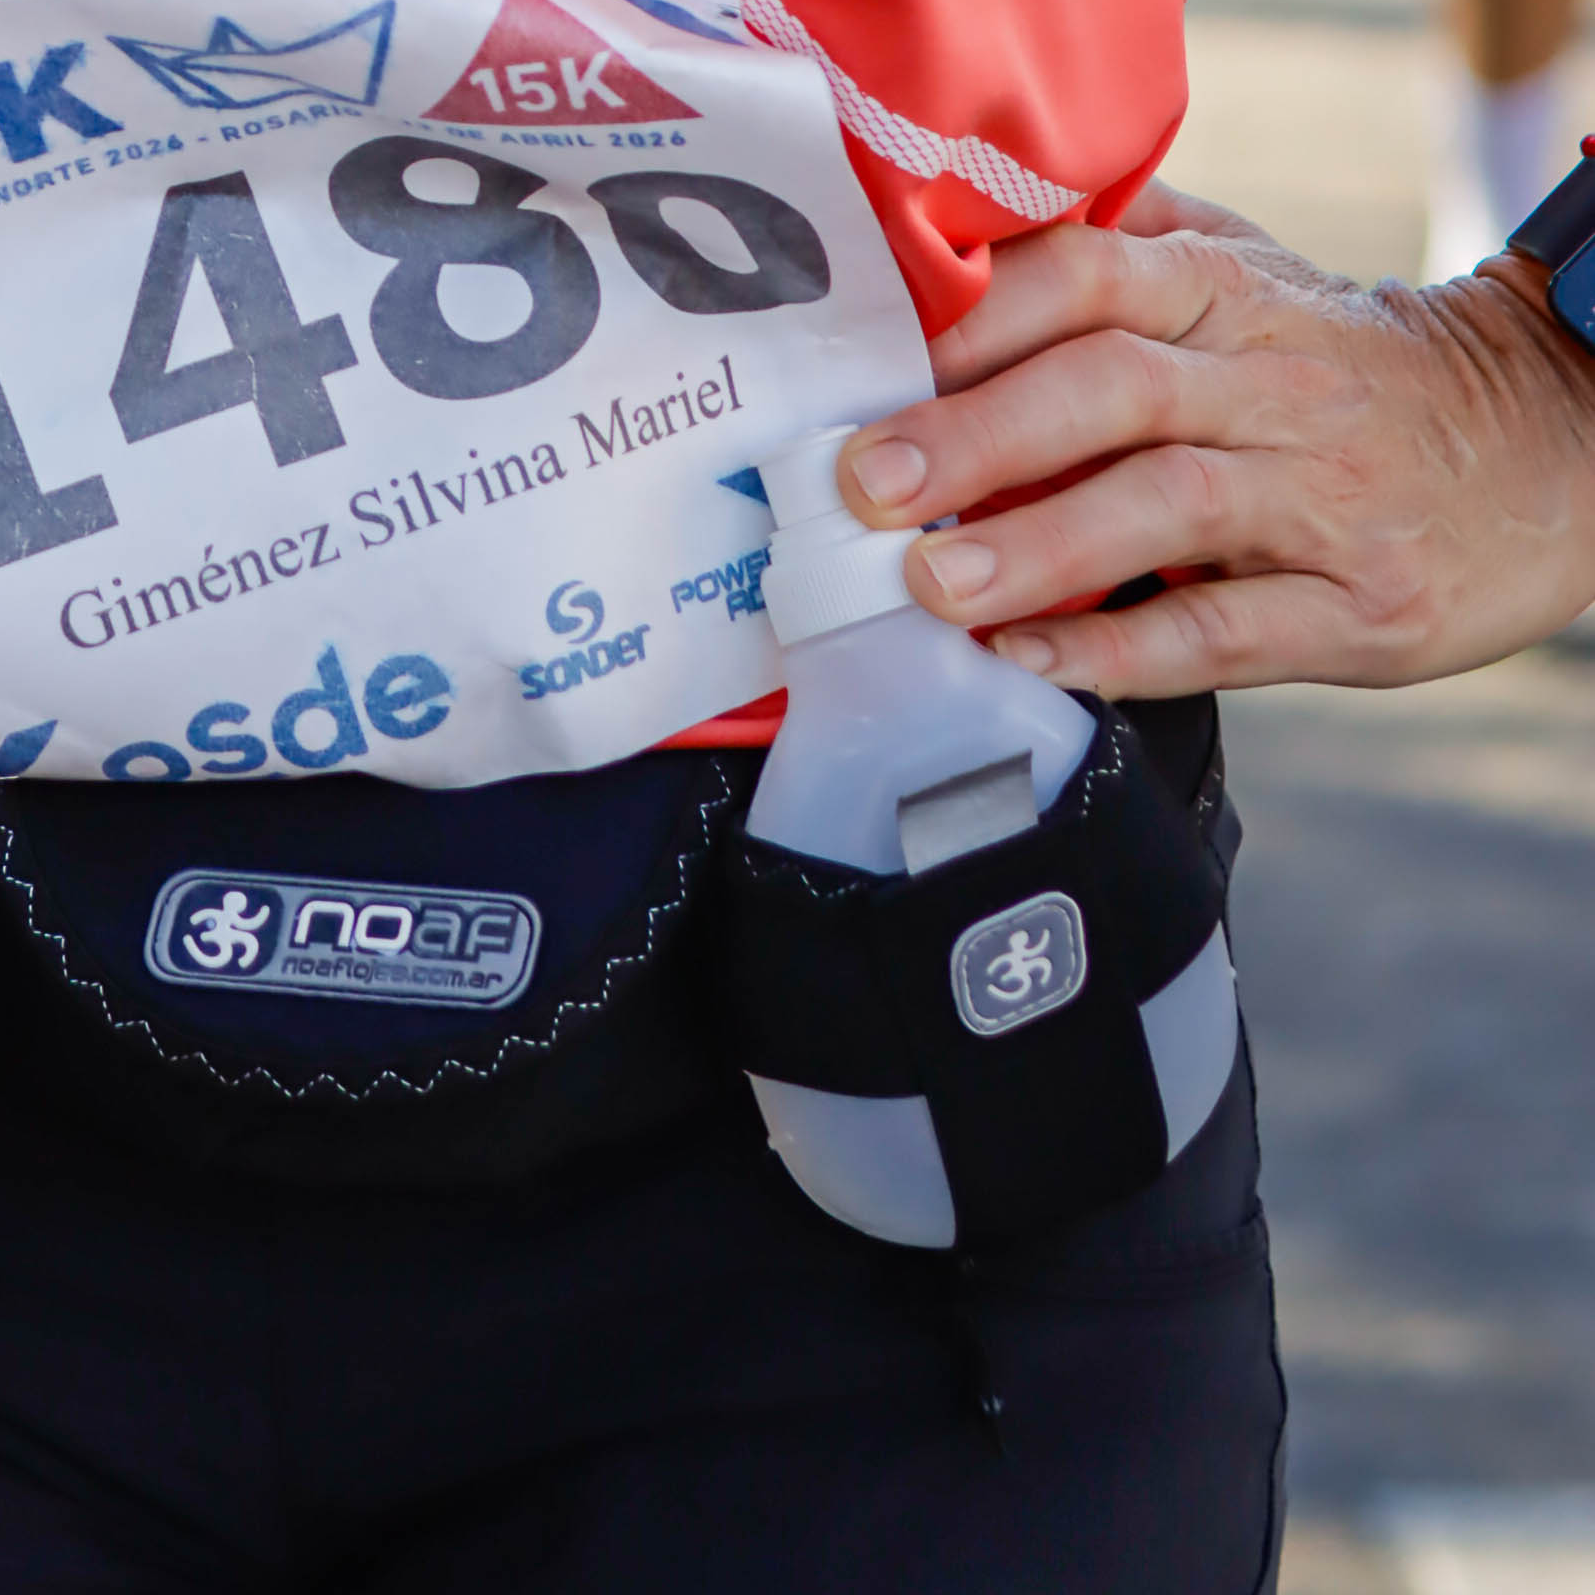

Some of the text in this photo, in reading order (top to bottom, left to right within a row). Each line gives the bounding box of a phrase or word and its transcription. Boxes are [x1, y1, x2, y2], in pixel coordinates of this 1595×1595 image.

[469, 51, 625, 113] 15K
[107, 134, 185, 169] 2026
[220, 104, 363, 143] ROSARIO
[501, 130, 595, 148] ABRIL
[609, 130, 687, 148] 2026
[60, 355, 744, 649] Giménez Silvina Mariel
[670, 546, 773, 614] POWE
[102, 644, 451, 781] osde
